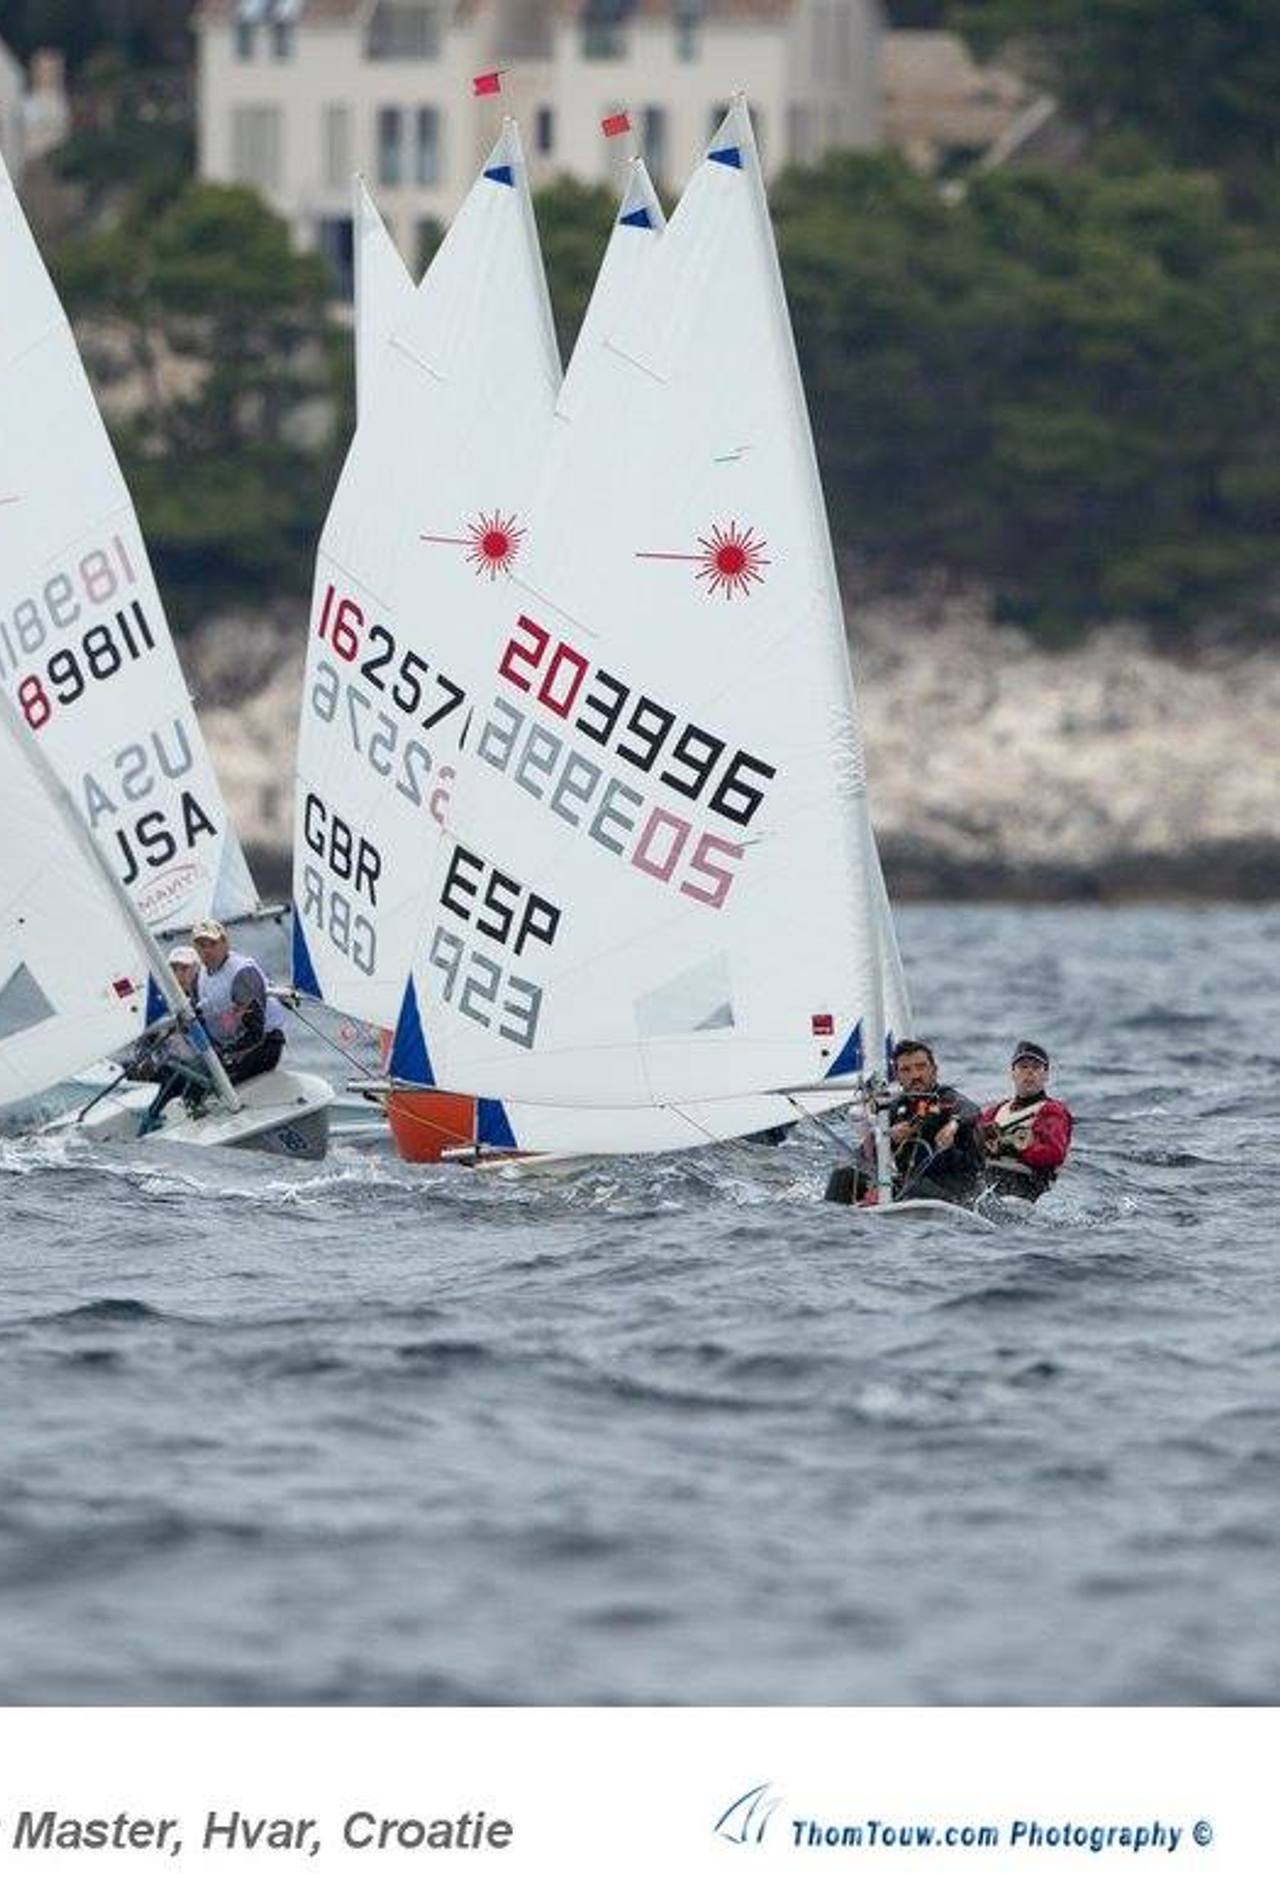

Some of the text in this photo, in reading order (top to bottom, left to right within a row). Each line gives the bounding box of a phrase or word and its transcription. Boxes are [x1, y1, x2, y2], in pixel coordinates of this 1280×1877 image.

[319, 585, 473, 750] 16257
[498, 614, 776, 827] 203996
[304, 792, 382, 907] GBR
[440, 844, 561, 956] ESP
